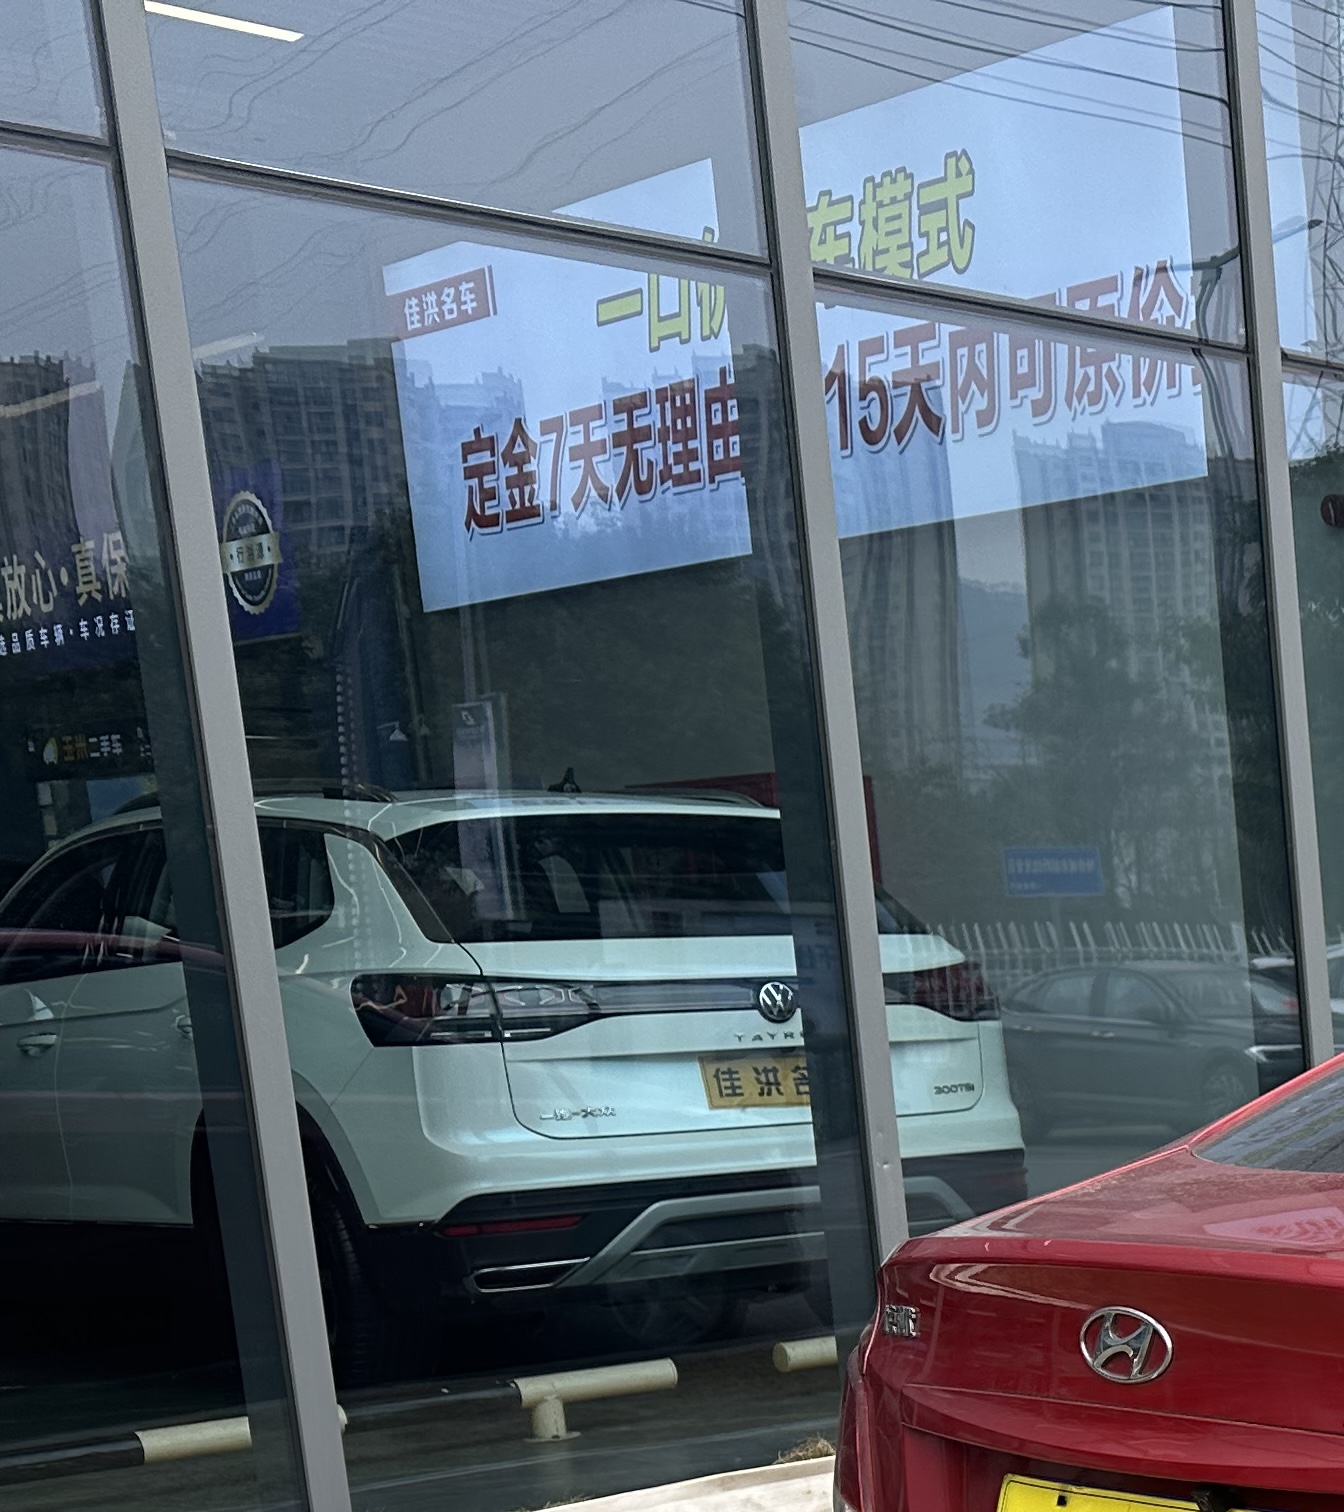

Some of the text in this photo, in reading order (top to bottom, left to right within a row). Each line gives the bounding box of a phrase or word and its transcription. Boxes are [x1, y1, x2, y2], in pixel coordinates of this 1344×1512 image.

[404, 281, 478, 331] 佳洪名车
[461, 366, 742, 534] 定金7天无理由
[0, 531, 130, 622] 放心·真保
[733, 1030, 805, 1042] TAYR
